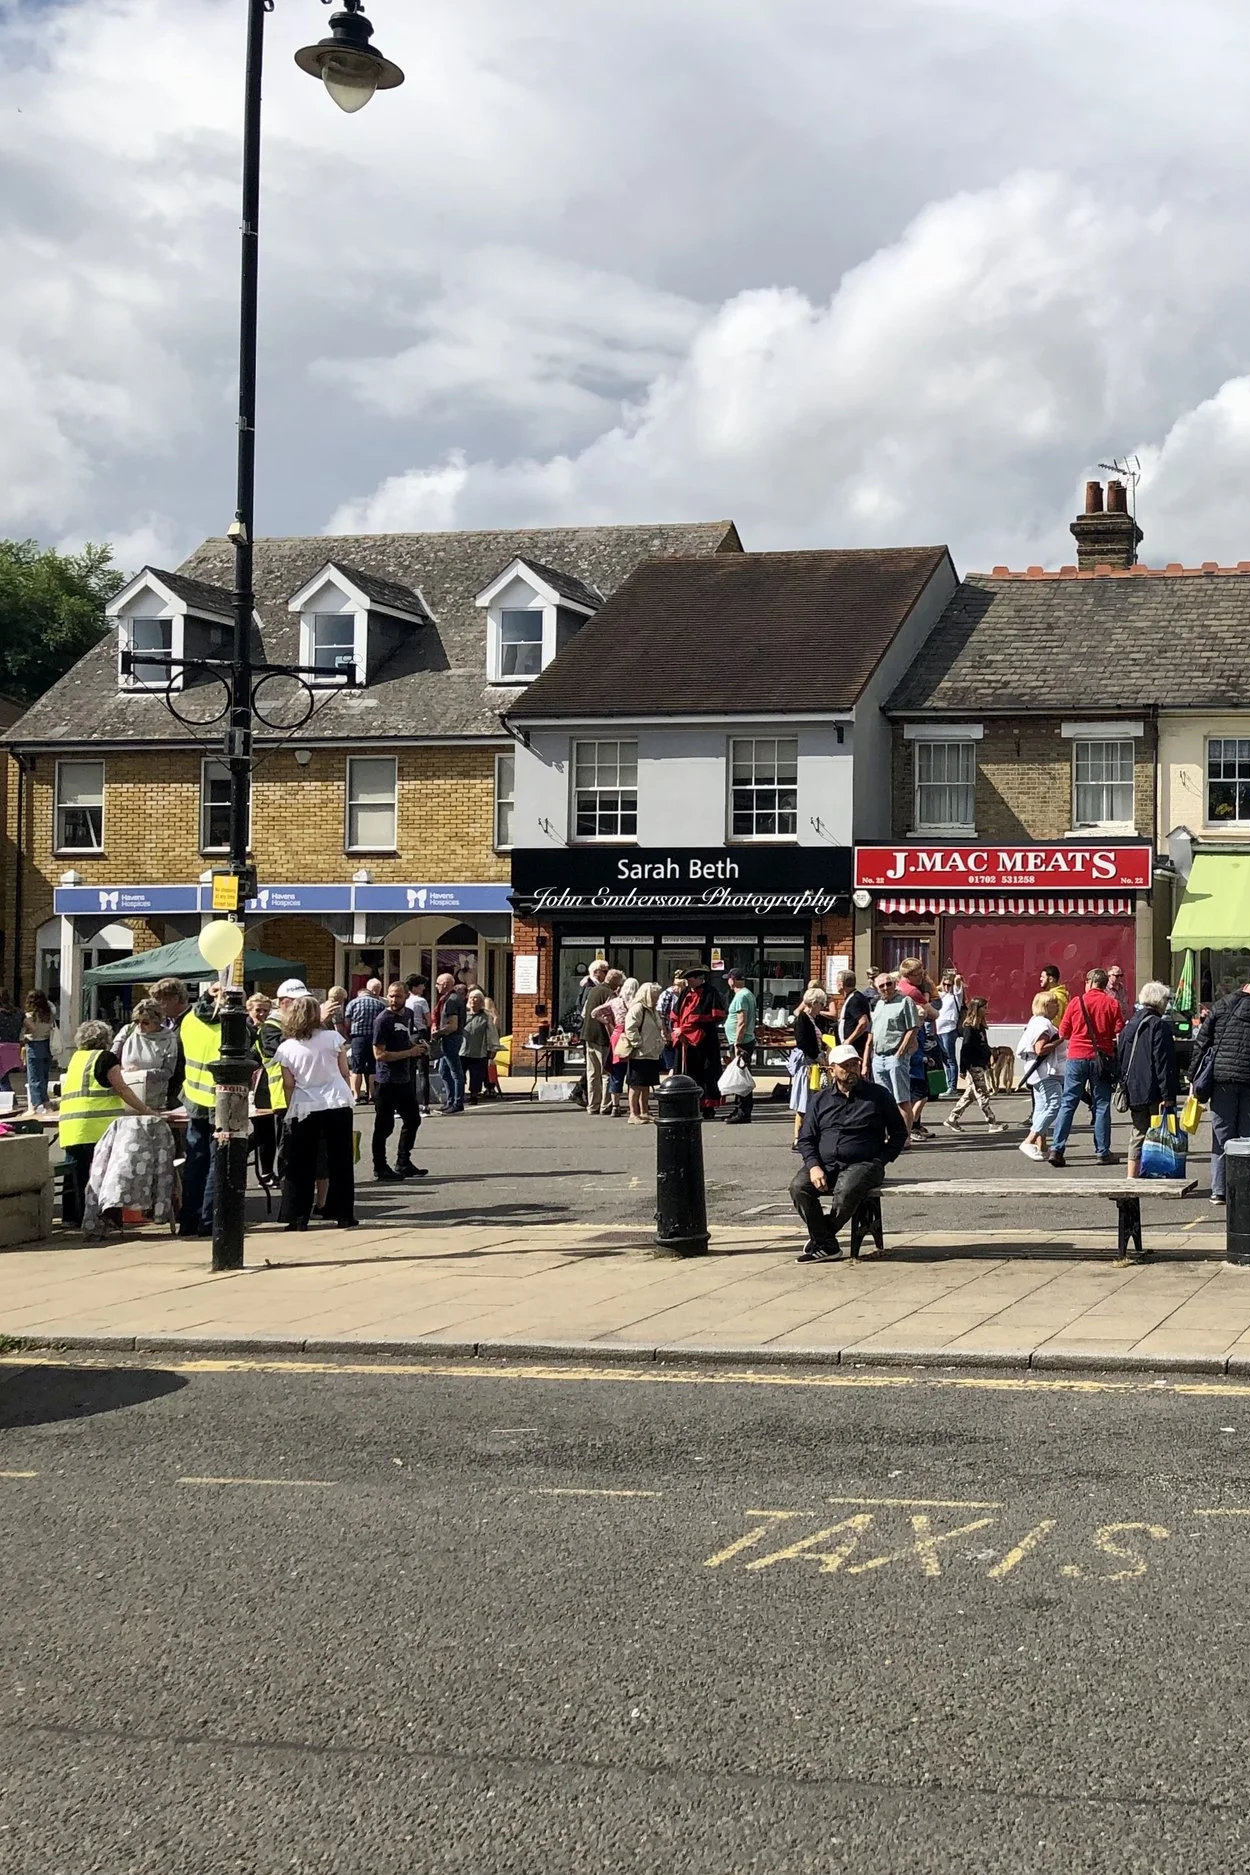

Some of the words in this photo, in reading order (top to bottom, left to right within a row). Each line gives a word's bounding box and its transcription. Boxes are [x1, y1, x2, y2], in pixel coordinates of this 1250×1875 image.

[617, 858, 680, 879] Sarah
[689, 858, 739, 879] Beth
[886, 851, 988, 879] J.MAC
[997, 851, 1118, 879] MEATS
[968, 875, 997, 884] 01702
[1001, 875, 1036, 884] 531258
[121, 900, 151, 908] Hospices
[271, 899, 301, 907] Hospices
[532, 886, 586, 914] John
[591, 886, 694, 908] Emberson
[698, 886, 837, 914] Photography
[702, 1509, 1172, 1582] TAXIS
